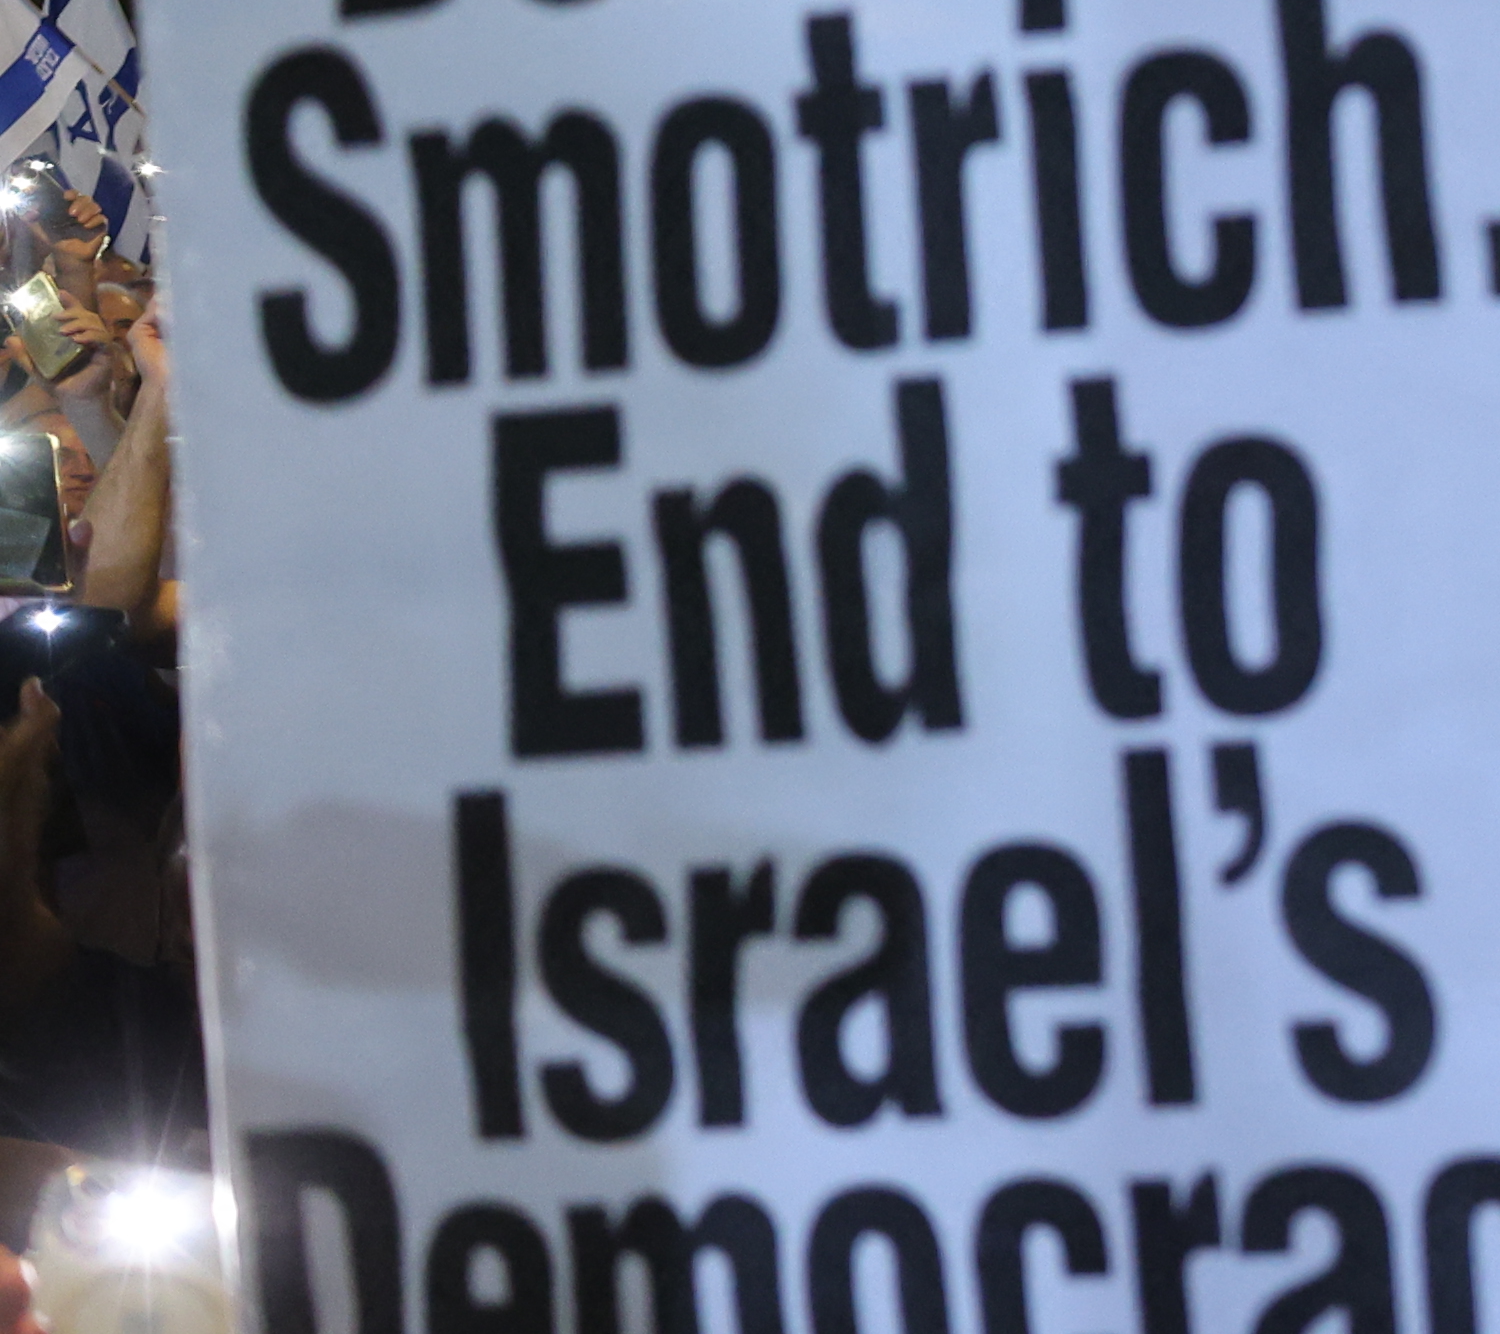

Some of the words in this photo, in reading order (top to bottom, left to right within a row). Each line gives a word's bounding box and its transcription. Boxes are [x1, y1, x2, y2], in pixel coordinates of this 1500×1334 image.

[492, 378, 970, 764] End
[1056, 374, 1325, 724] to
[450, 742, 1438, 1145] Israel's
